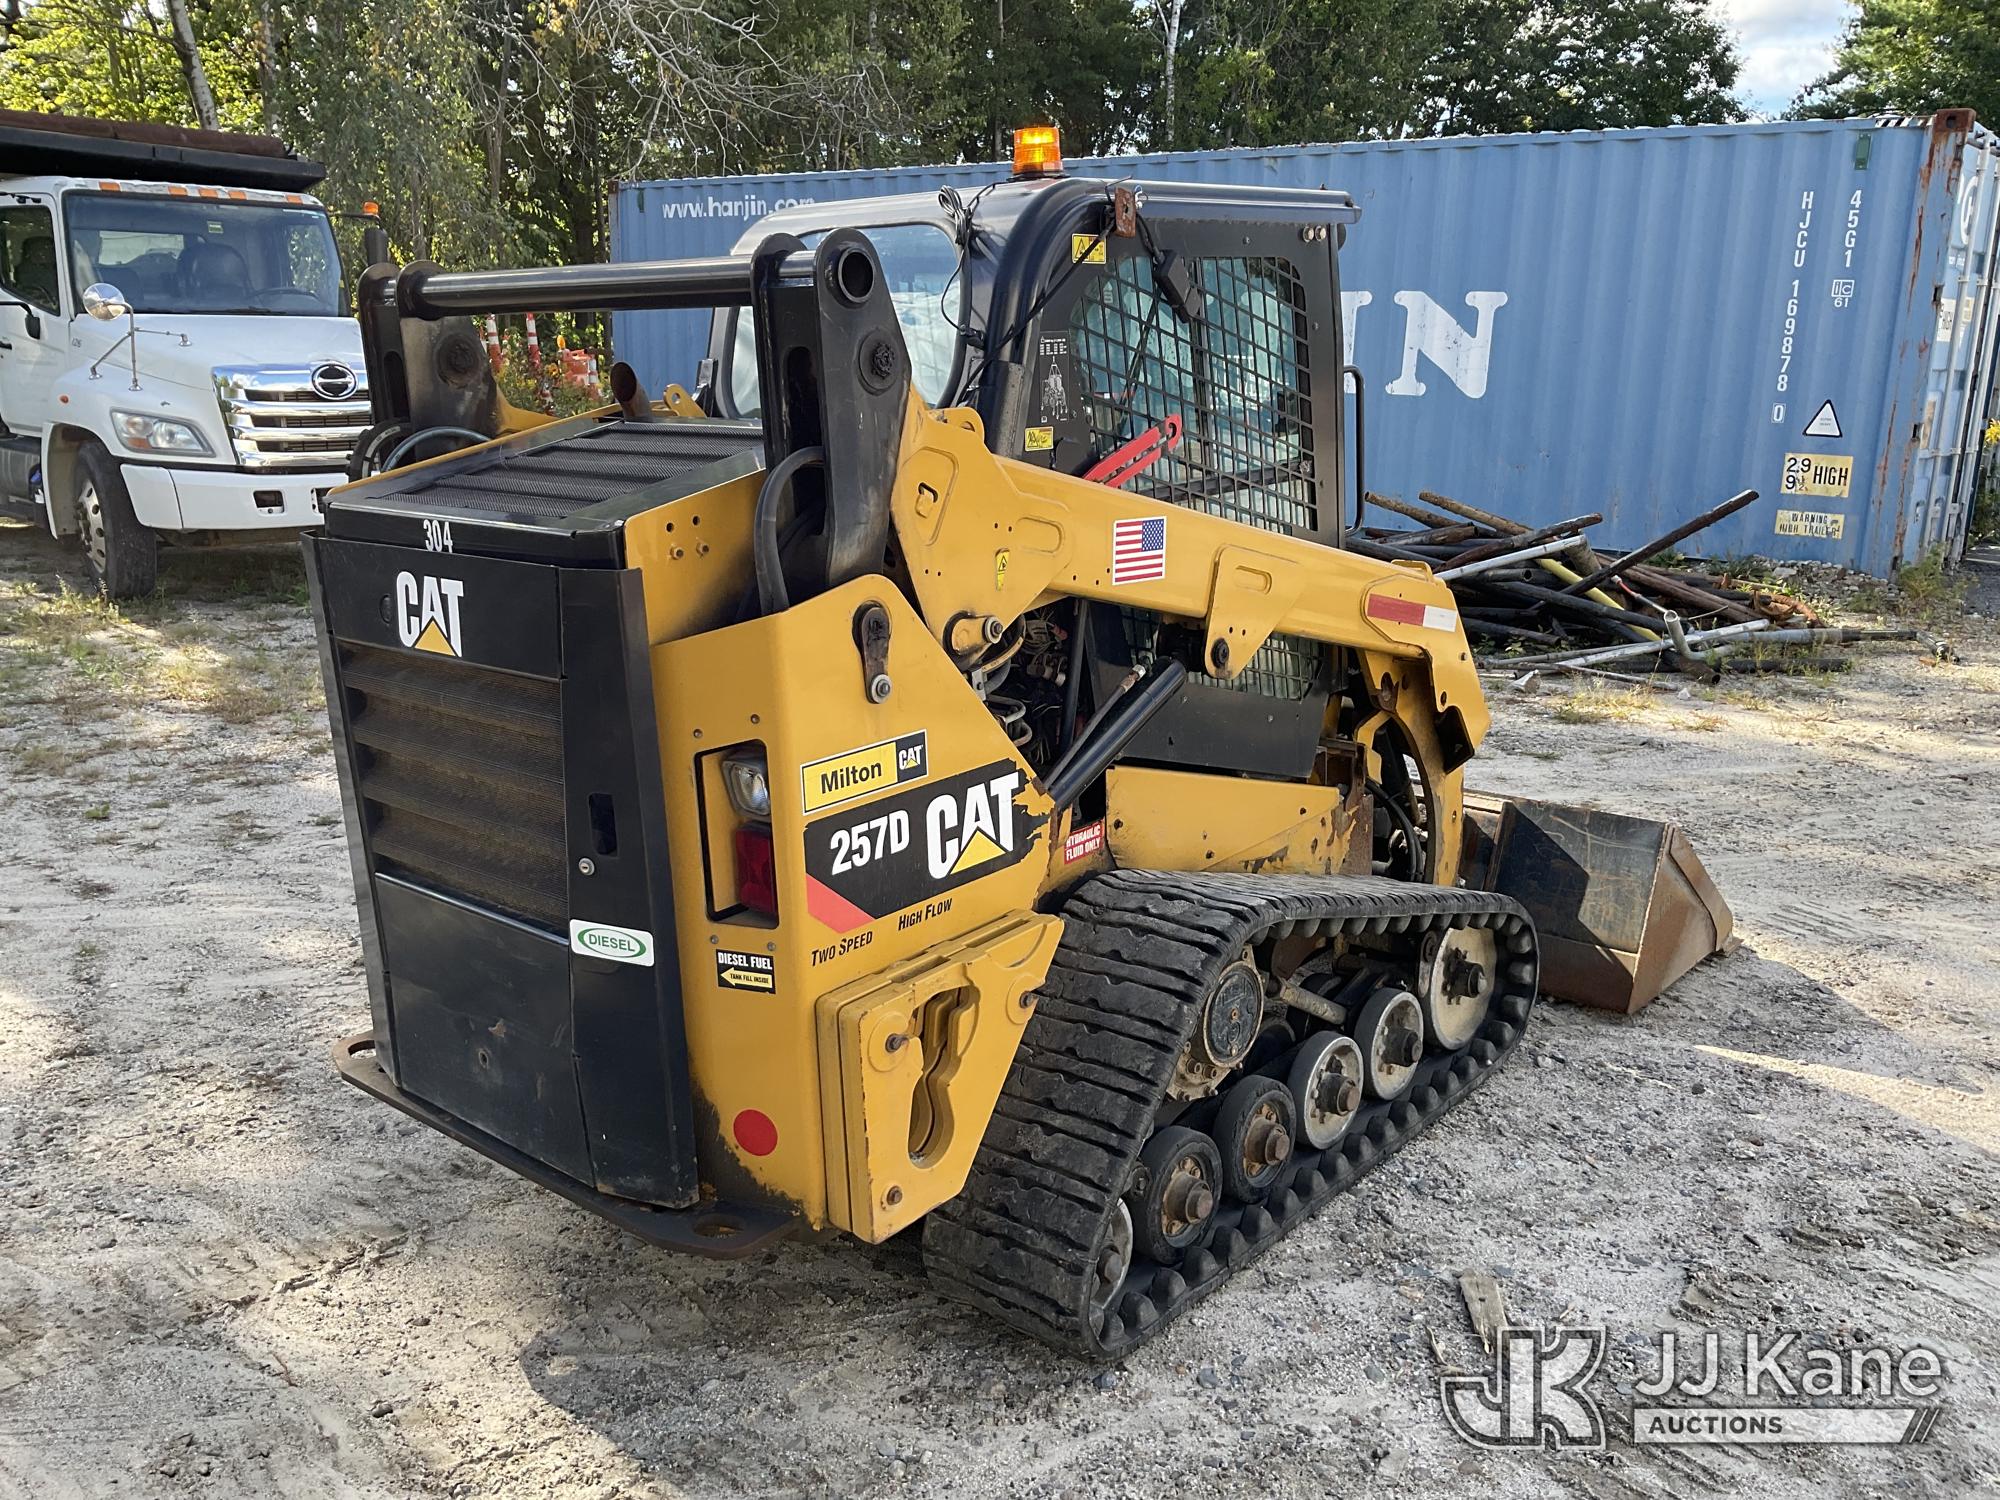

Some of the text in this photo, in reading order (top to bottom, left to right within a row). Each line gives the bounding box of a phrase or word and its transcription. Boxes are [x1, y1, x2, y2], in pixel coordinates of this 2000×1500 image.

[1793, 191, 1814, 267] HJCU
[1844, 190, 1862, 267] 45G1
[1834, 298, 1849, 308] 61
[1776, 280, 1799, 391] 169878
[1813, 466, 1849, 486] HIGH
[1779, 523, 1799, 533] HIGH
[1792, 513, 1828, 525] WARNING
[423, 519, 454, 553] 304
[396, 571, 464, 658] CAT
[820, 745, 922, 794] Milton CAT
[830, 771, 1019, 880] 257D CAT
[1066, 825, 1101, 848] HYDRAULIC
[1066, 837, 1101, 861] FLUID ONLY
[588, 934, 635, 952] DIESEL
[717, 952, 773, 970] DIESEL FUEL
[753, 976, 769, 984] INSIDE
